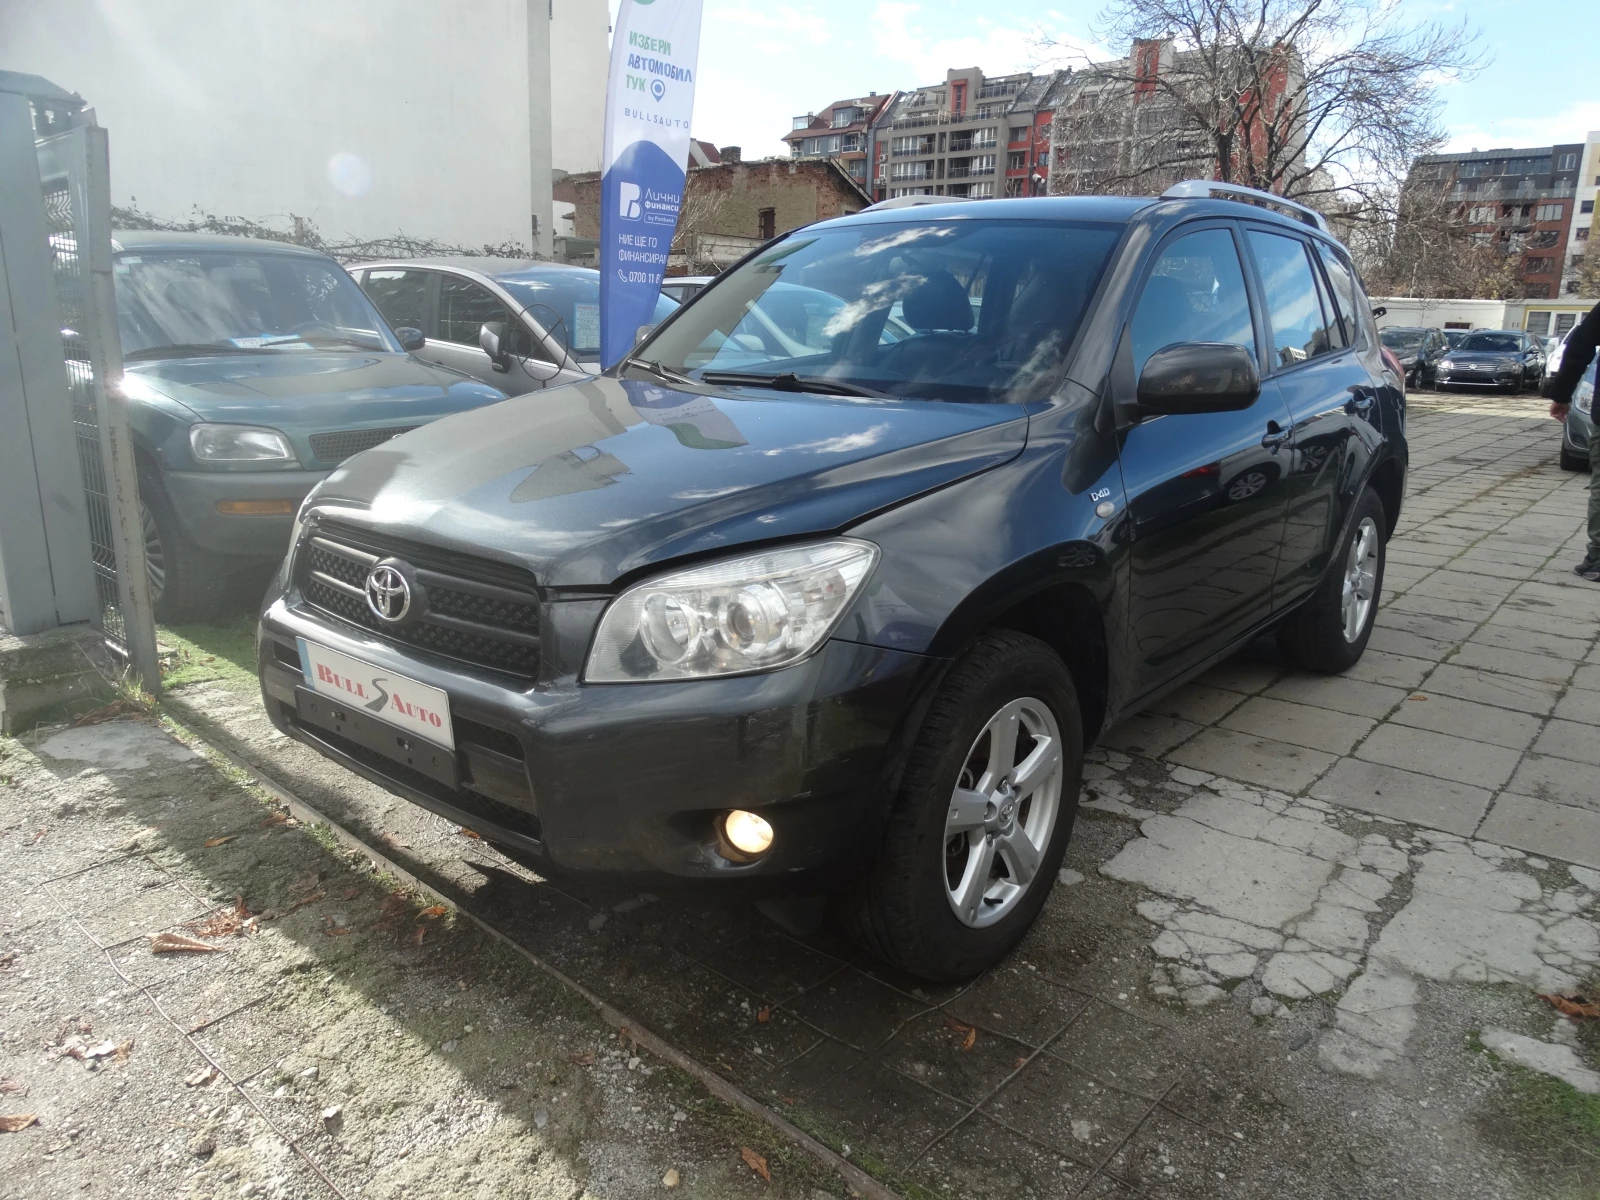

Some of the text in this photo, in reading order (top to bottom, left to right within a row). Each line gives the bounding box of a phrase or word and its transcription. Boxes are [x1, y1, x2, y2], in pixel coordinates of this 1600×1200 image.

[629, 31, 671, 56] ИЗБЕРИ
[628, 53, 692, 83] АВТОМОБИЛ
[625, 74, 646, 92] ТУК
[624, 108, 689, 129] BULLSAUTO
[645, 188, 680, 204] Лични
[644, 200, 679, 212] Финанси
[618, 233, 658, 248] НИЕ ЩЕ ГО
[629, 271, 647, 283] 0700
[648, 273, 654, 284] 11
